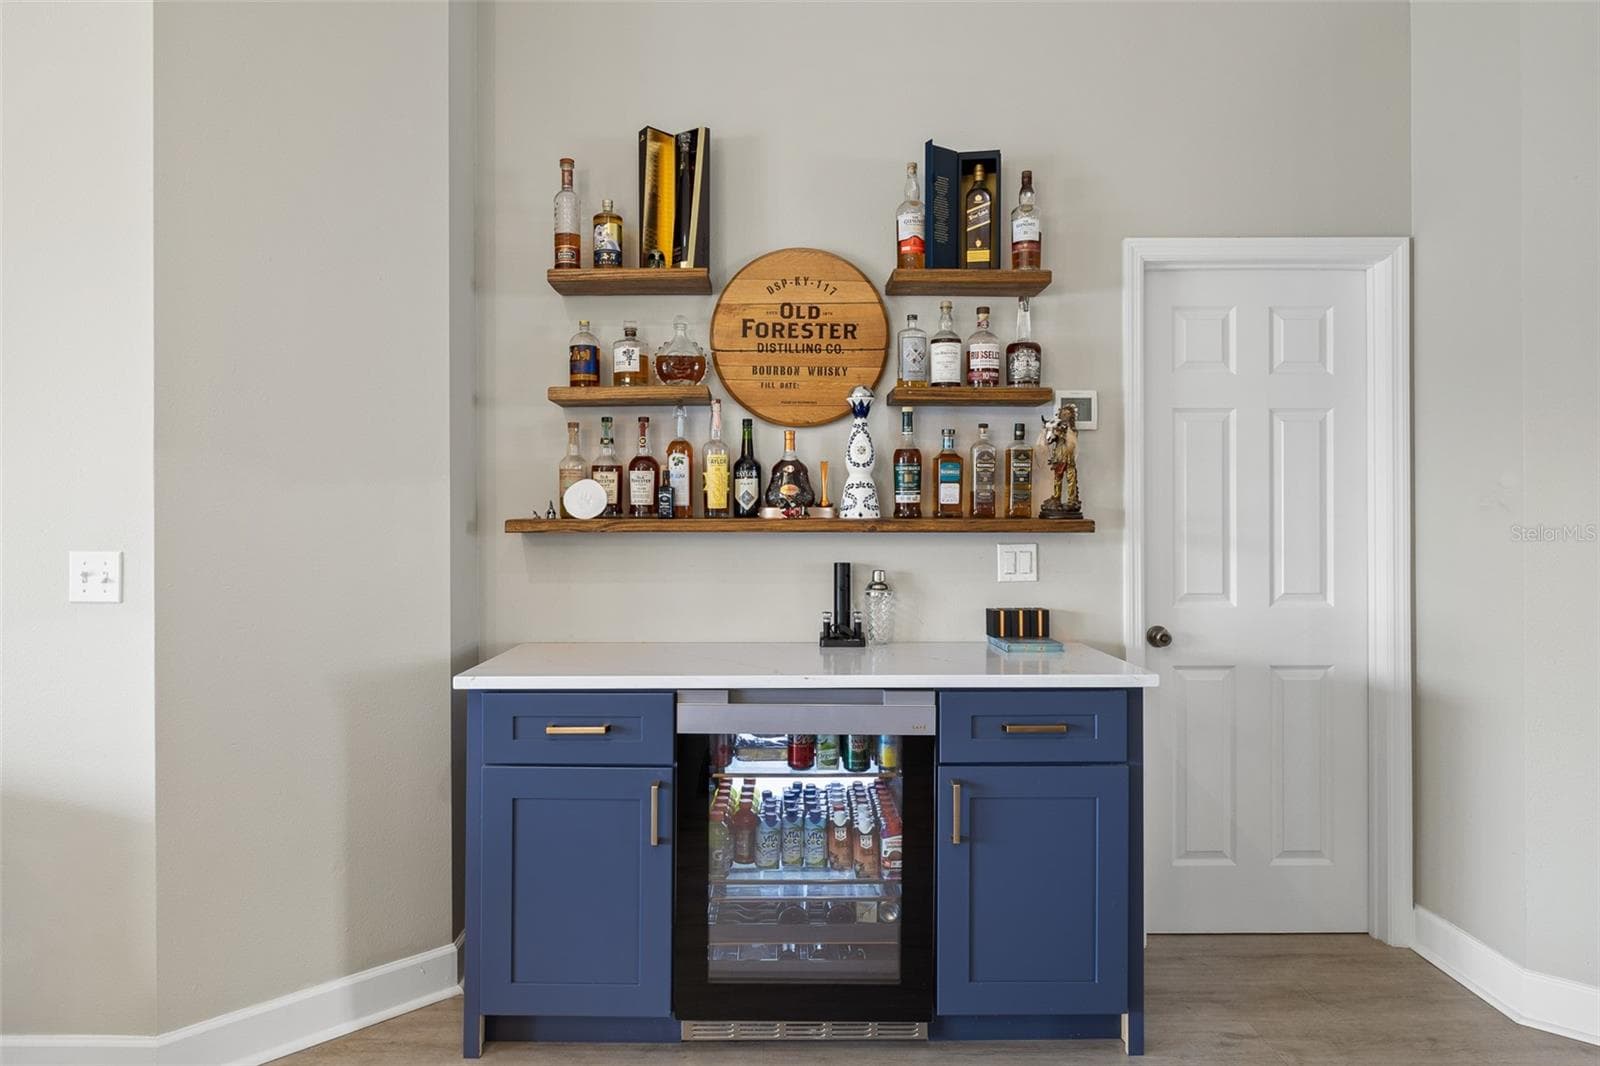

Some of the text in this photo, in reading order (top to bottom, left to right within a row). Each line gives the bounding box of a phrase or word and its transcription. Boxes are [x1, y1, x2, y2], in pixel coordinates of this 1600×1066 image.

[766, 276, 839, 296] DSP-KY-117
[780, 302, 820, 319] OLD
[742, 318, 858, 339] FORESTER
[757, 343, 845, 355] DISTILLING CO.
[752, 366, 848, 377] BOURBON WHISKY
